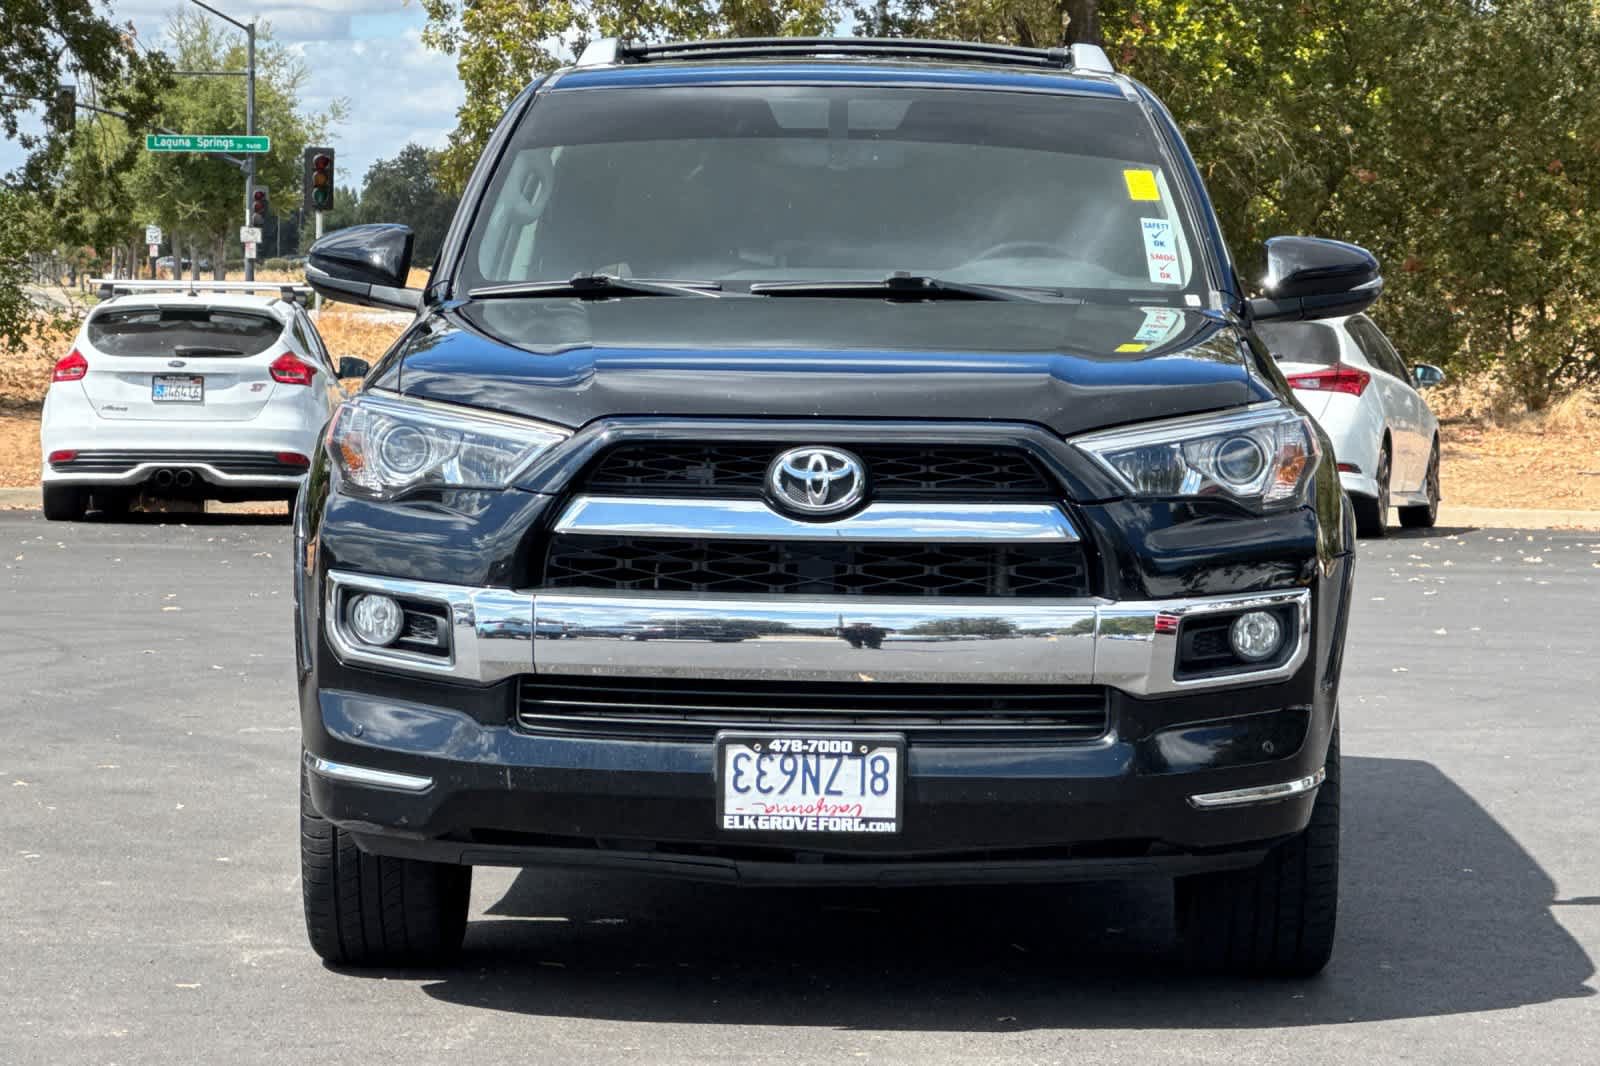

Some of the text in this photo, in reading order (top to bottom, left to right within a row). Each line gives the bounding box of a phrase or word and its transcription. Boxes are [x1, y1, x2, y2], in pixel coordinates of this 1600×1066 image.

[154, 137, 191, 149] Laguna
[197, 137, 234, 149] Springs
[1143, 222, 1169, 230] SAFETY
[1151, 253, 1176, 261] SMOG
[768, 739, 853, 754] 478-7000
